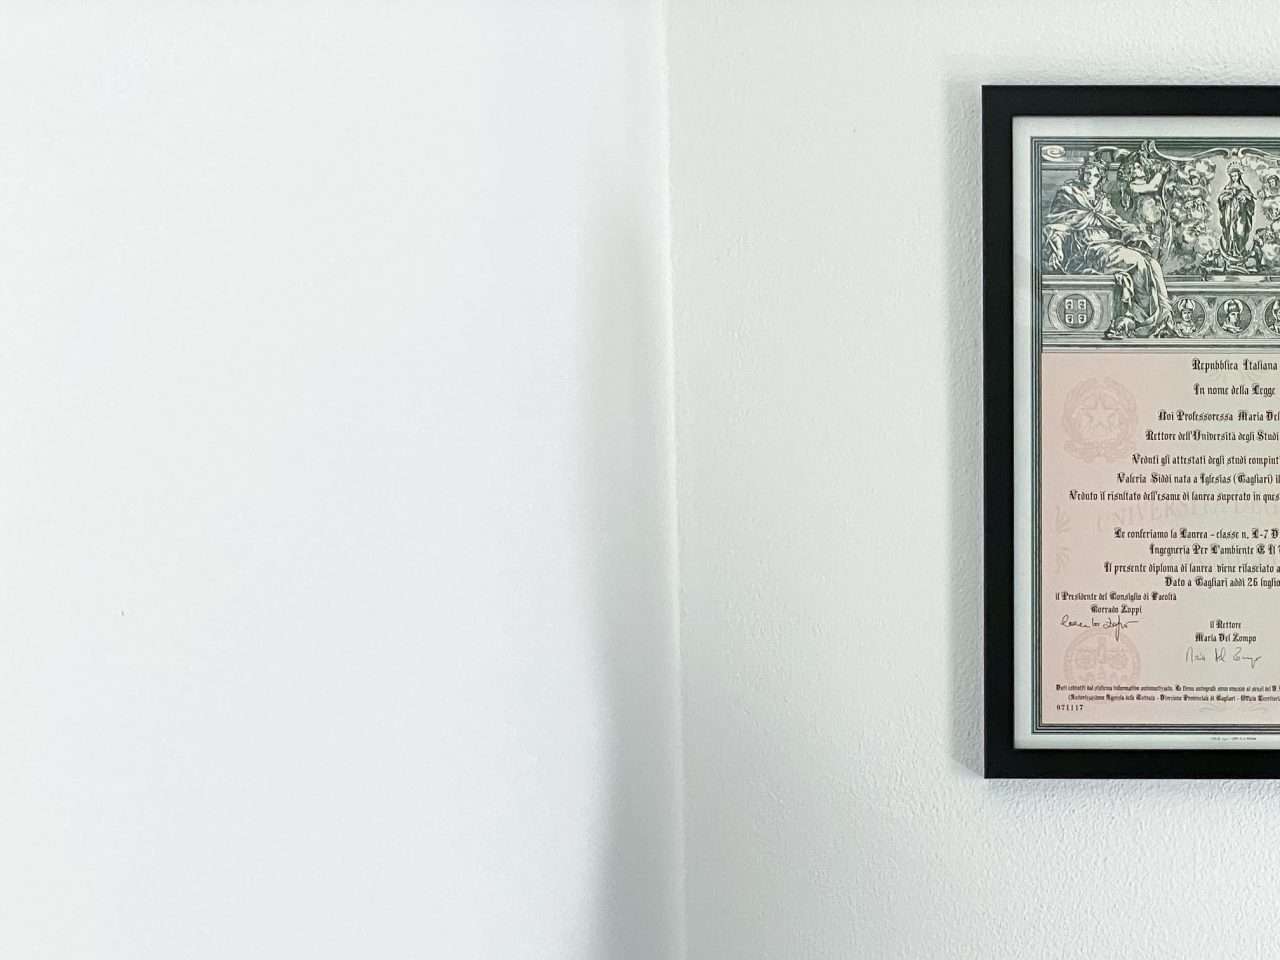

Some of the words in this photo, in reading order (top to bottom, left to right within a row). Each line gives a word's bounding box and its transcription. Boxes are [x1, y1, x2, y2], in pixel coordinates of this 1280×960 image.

[1192, 358, 1239, 374] Repubblica
[1243, 359, 1278, 371] Italiana
[1194, 383, 1205, 396] In
[1208, 387, 1229, 395] nome
[1231, 385, 1249, 395] della
[1252, 383, 1276, 398] Legge
[1176, 410, 1233, 422] Professoressa
[1238, 410, 1264, 422] Maria
[1266, 410, 1280, 421] Del
[1145, 430, 1176, 441] Rettore
[1238, 432, 1255, 444] degli
[1257, 430, 1279, 441] Studi
[1132, 454, 1159, 465] Veduti
[1161, 455, 1170, 467] gli
[1173, 456, 1206, 465] attestati
[1208, 456, 1225, 467] degli
[1227, 456, 1247, 465] studi
[1117, 472, 1147, 484] Valeria
[1150, 472, 1172, 484] Siddi
[1174, 475, 1191, 484] nata
[1194, 476, 1198, 484] a
[1200, 473, 1231, 486] Iglesias
[1276, 474, 1280, 484] il
[1165, 577, 1185, 587] Dato
[1248, 578, 1258, 587] 26
[1261, 577, 1280, 589] luglio
